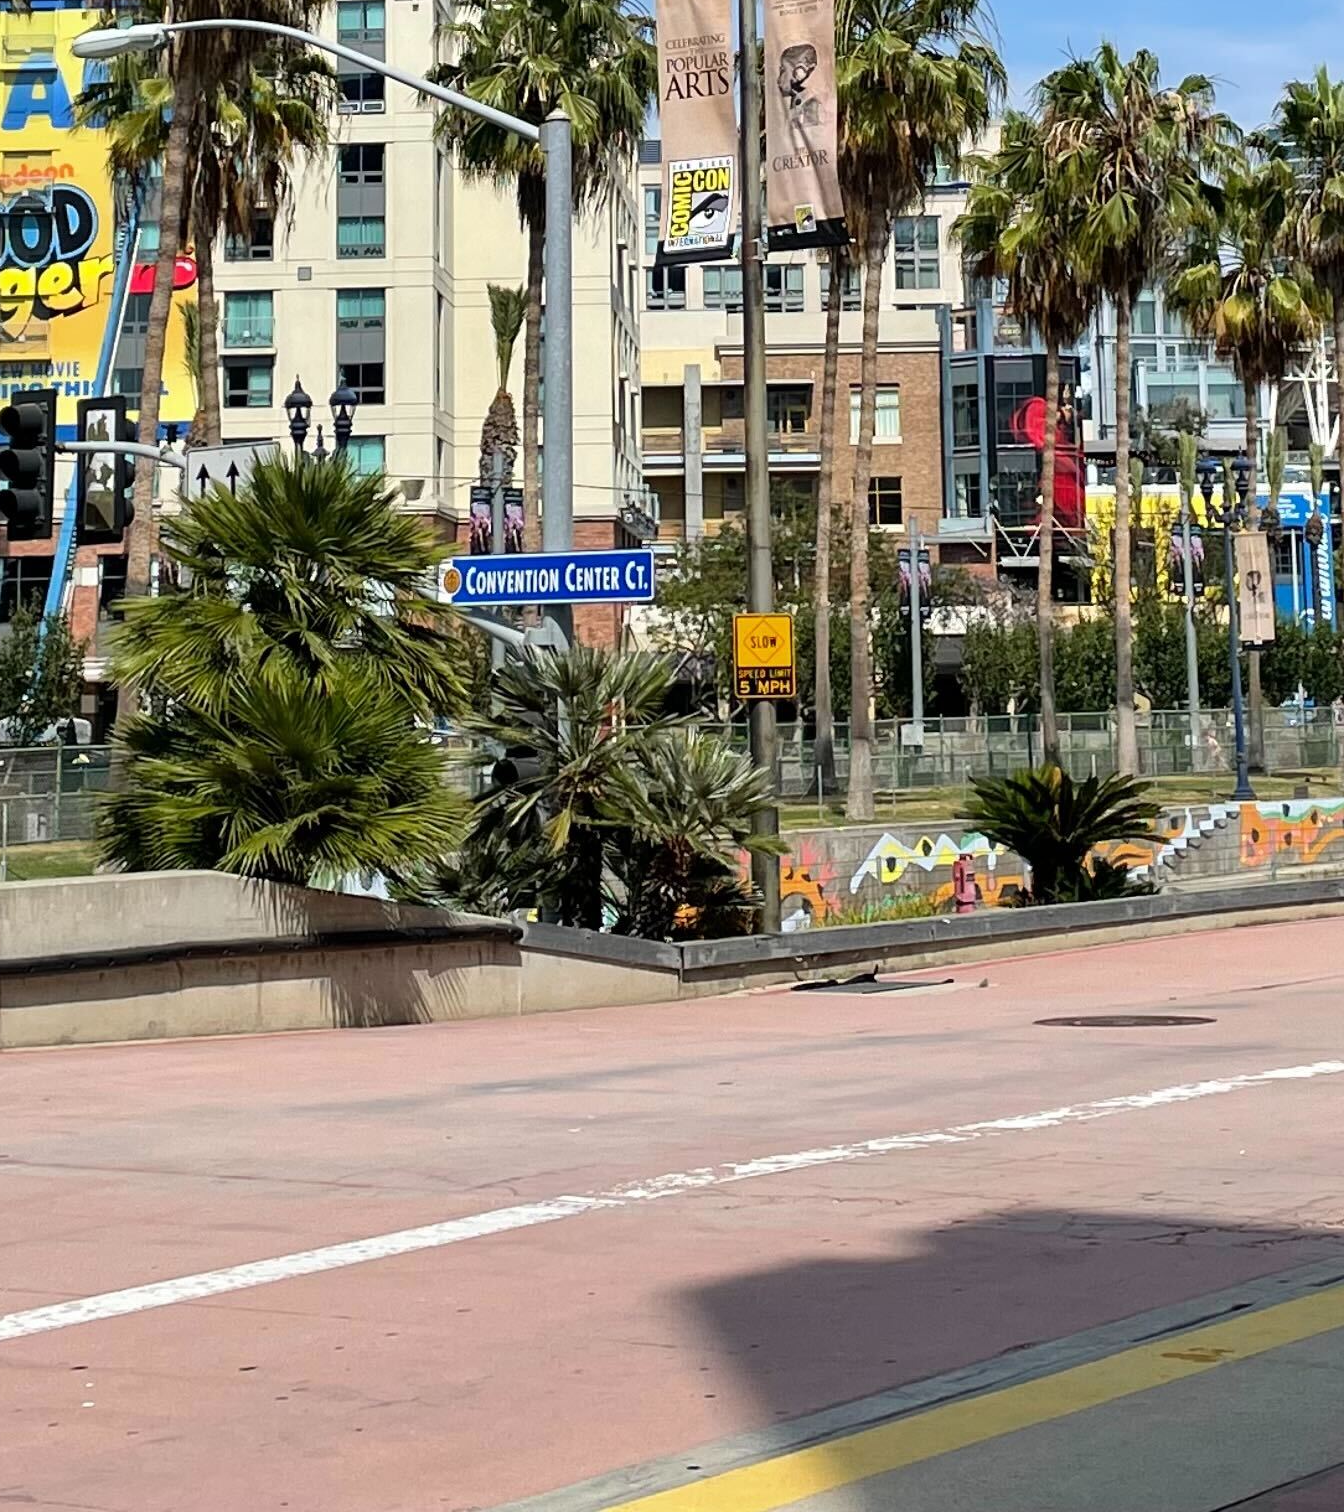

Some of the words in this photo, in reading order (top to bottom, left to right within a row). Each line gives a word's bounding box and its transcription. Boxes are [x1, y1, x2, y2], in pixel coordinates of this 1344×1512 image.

[666, 52, 729, 73] POPULAR
[664, 67, 729, 101] ARTS
[773, 149, 829, 172] CREATOR
[670, 171, 692, 236] COMIC
[692, 168, 729, 192] CON
[31, 361, 80, 378] MOVIE
[51, 380, 94, 397] THI
[750, 635, 777, 648] SLOW
[740, 680, 750, 694] 5
[758, 679, 791, 694] MPH
